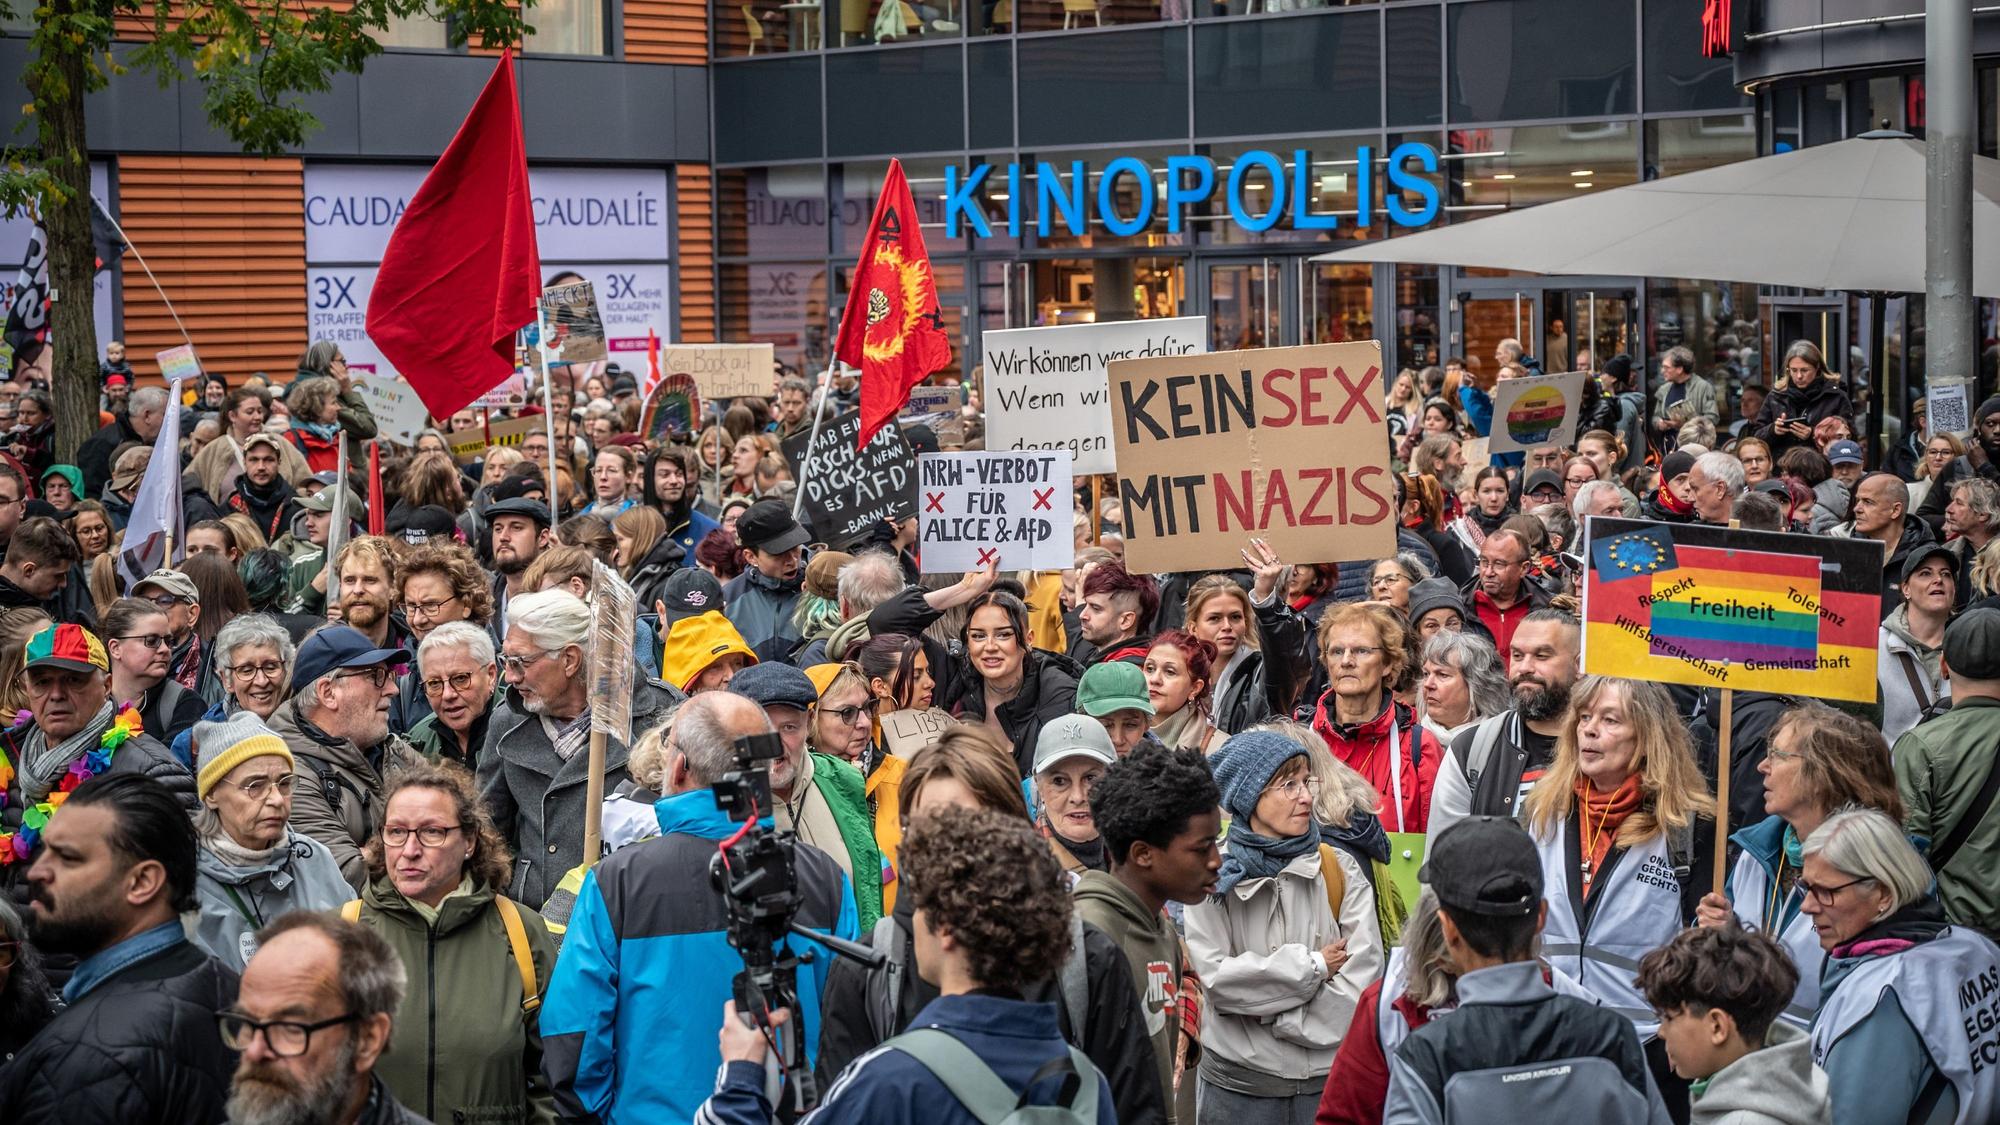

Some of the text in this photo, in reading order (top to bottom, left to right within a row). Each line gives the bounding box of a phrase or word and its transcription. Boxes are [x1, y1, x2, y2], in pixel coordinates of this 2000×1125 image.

[945, 142, 1442, 239] KINOPOLIS
[306, 197, 406, 227] CAUDA
[314, 276, 356, 309] 3X
[607, 274, 662, 299] 3X MEHR
[607, 302, 661, 312] KOLLAGEN IN
[607, 316, 624, 324] DER
[315, 330, 335, 341] ALS
[1097, 350, 1135, 369] was
[1138, 336, 1196, 358] dafür
[372, 386, 403, 403] BUNT
[997, 383, 1107, 412] Wenn wi
[1120, 365, 1382, 444] KEIN SEX
[872, 444, 904, 467] NENN
[824, 494, 845, 512] ES
[967, 487, 1007, 515] FÜR
[1120, 465, 1391, 540] MIT NAZIS
[924, 517, 1053, 549] ALICE & AfD
[1638, 576, 1697, 609] Respekt
[1690, 596, 1775, 622] Freiheit
[1785, 586, 1847, 628] Toleranz
[1614, 614, 1729, 683] Hilfsbereitschaft
[1744, 656, 1851, 671] Gemeinschaft
[1636, 872, 1679, 893] RECHTS
[1641, 863, 1677, 881] GEGEN
[1958, 965, 2000, 1013] MAS
[1502, 1065, 1572, 1083] UNDER ARMOUR
